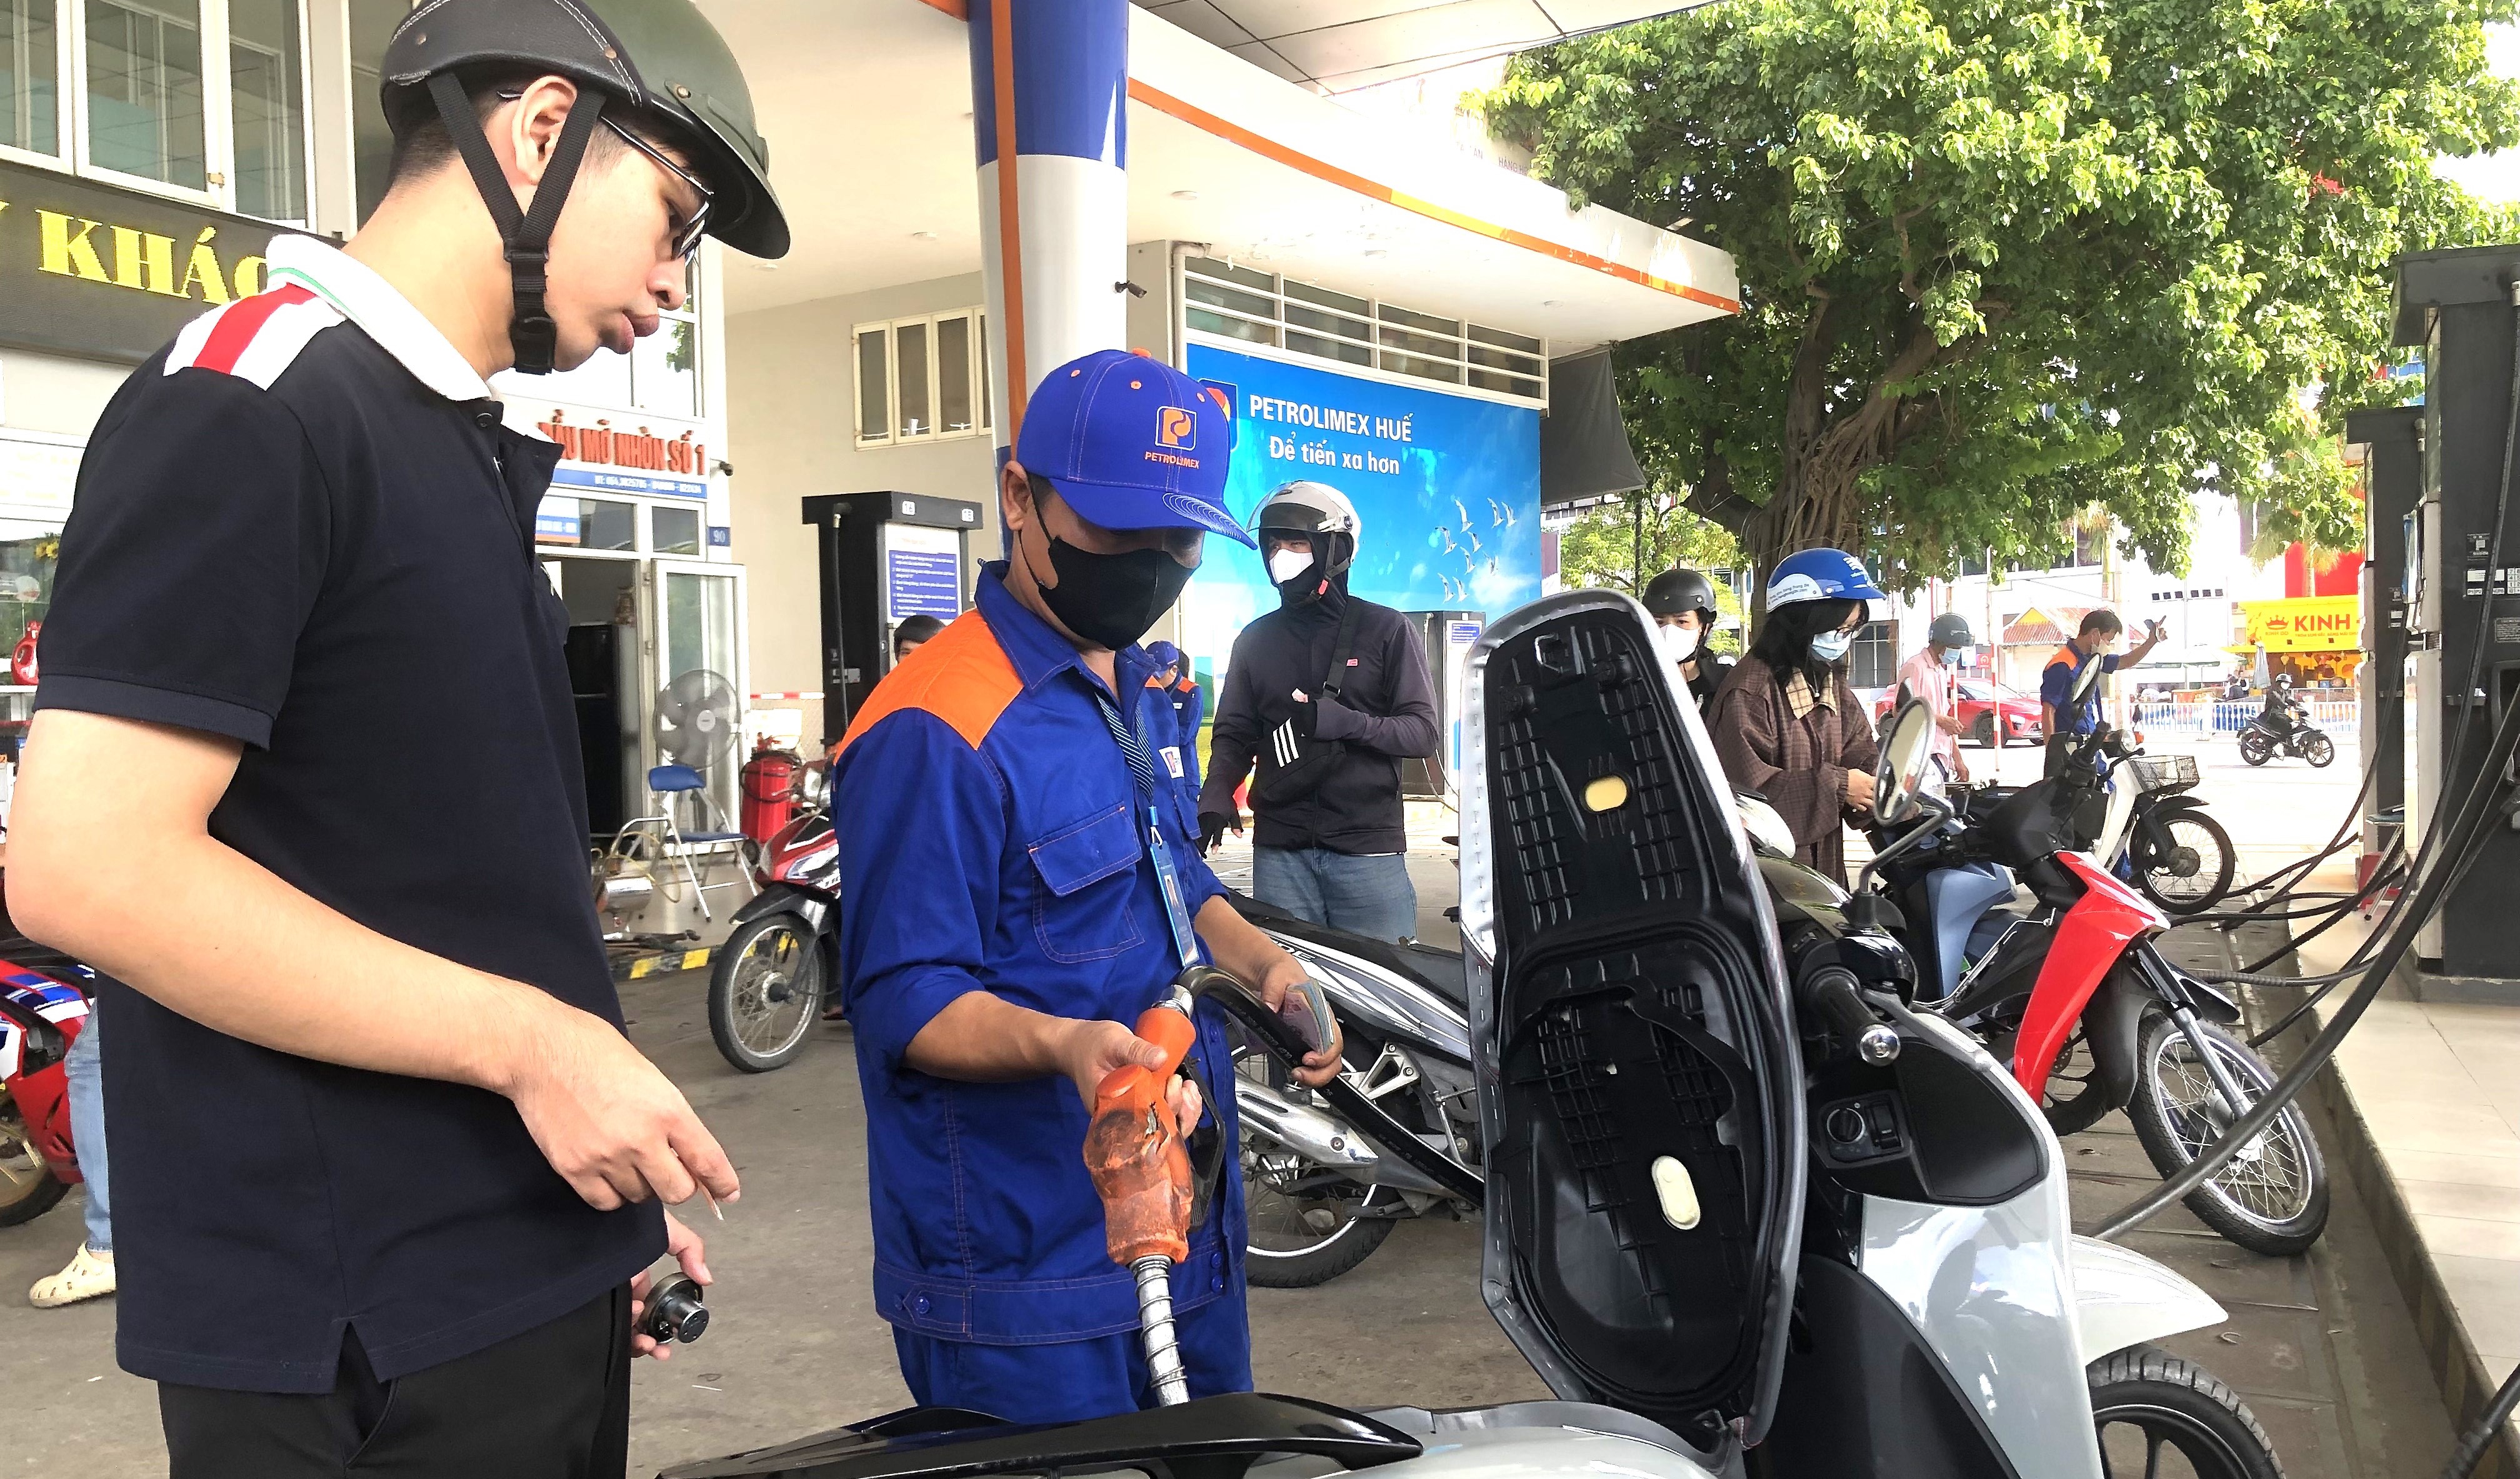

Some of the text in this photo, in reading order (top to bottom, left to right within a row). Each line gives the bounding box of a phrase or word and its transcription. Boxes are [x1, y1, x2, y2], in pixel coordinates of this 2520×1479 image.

[1249, 394, 1414, 443] PETROLIMEX HUẾ
[667, 430, 693, 474] SỐ
[694, 444, 706, 476] 1
[1144, 451, 1200, 469] PETROLIMEX
[1269, 431, 1400, 475] Để tiến xa hơn
[713, 529, 726, 543] 90
[2294, 614, 2351, 632] KINH
